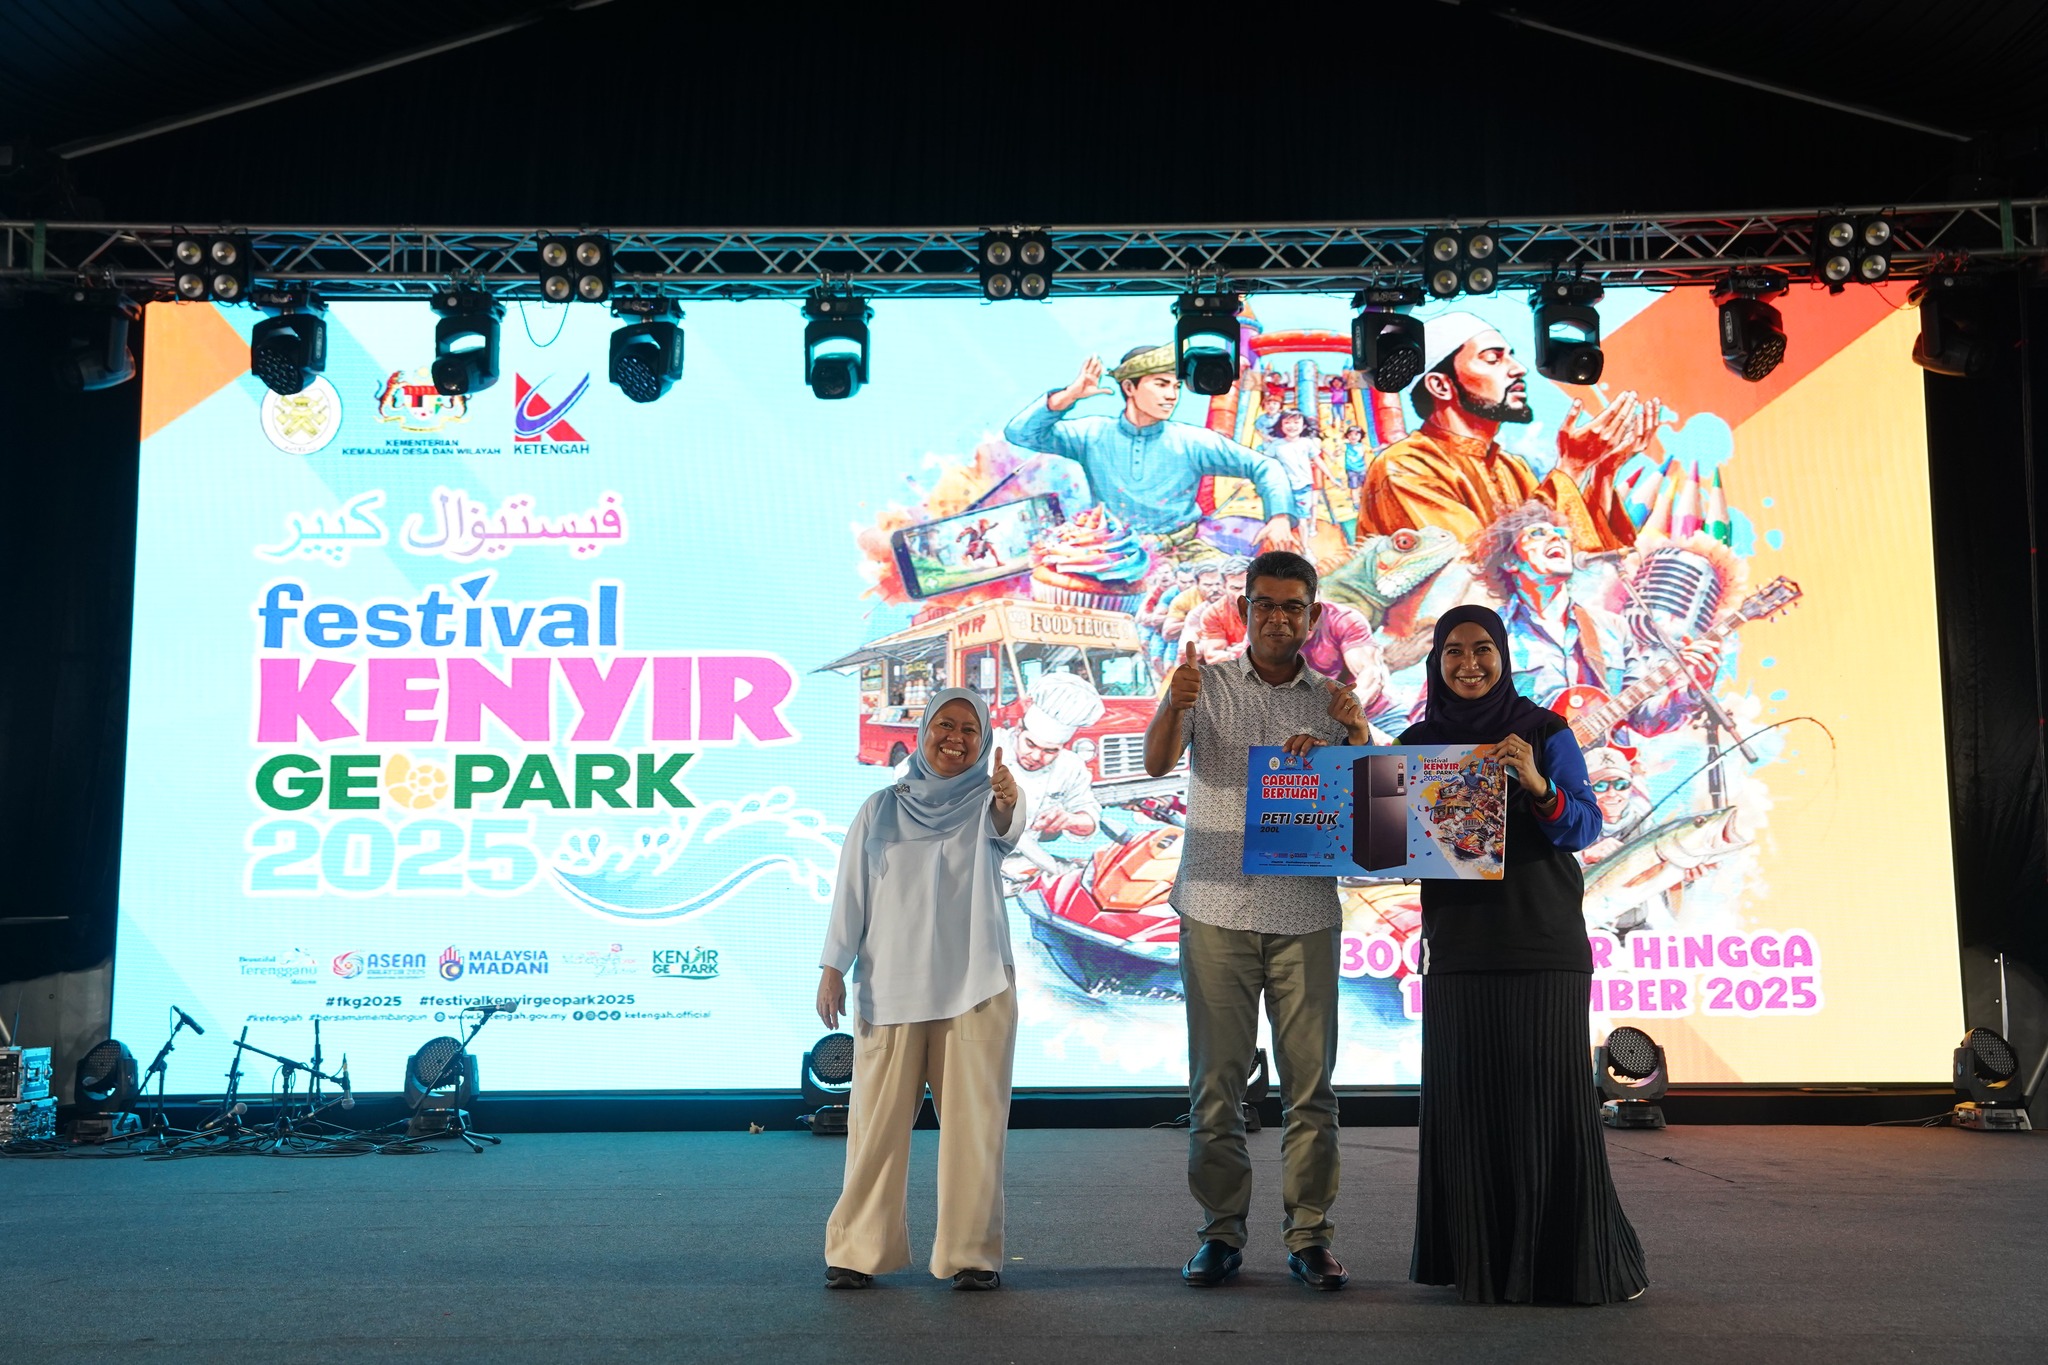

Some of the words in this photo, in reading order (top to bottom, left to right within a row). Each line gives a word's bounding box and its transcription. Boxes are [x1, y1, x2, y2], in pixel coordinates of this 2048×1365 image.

[385, 439, 459, 447] KEMENTERIAN
[513, 443, 590, 455] KETENGAH
[342, 447, 400, 455] KEMAJUAN
[402, 447, 430, 455] DESA
[432, 447, 454, 455] DAN
[258, 574, 618, 649] festival
[1031, 612, 1073, 635] FOOD
[256, 656, 794, 743] KENYIR
[1262, 774, 1320, 786] CABUTAN
[1262, 787, 1319, 800] BERTUAH
[1260, 811, 1292, 825] PETI
[1293, 812, 1340, 825] SEJUK
[249, 818, 539, 892] 2025
[367, 953, 427, 968] ASEAN
[469, 950, 549, 961] MALAYSIA
[1342, 937, 1394, 971] 30
[240, 965, 318, 978] Terengganu
[468, 962, 549, 975] MADANI
[1706, 976, 1818, 1010] 2025
[325, 996, 402, 1009] #fkg2025
[419, 994, 636, 1008] #festivalkenyirgeopark2025
